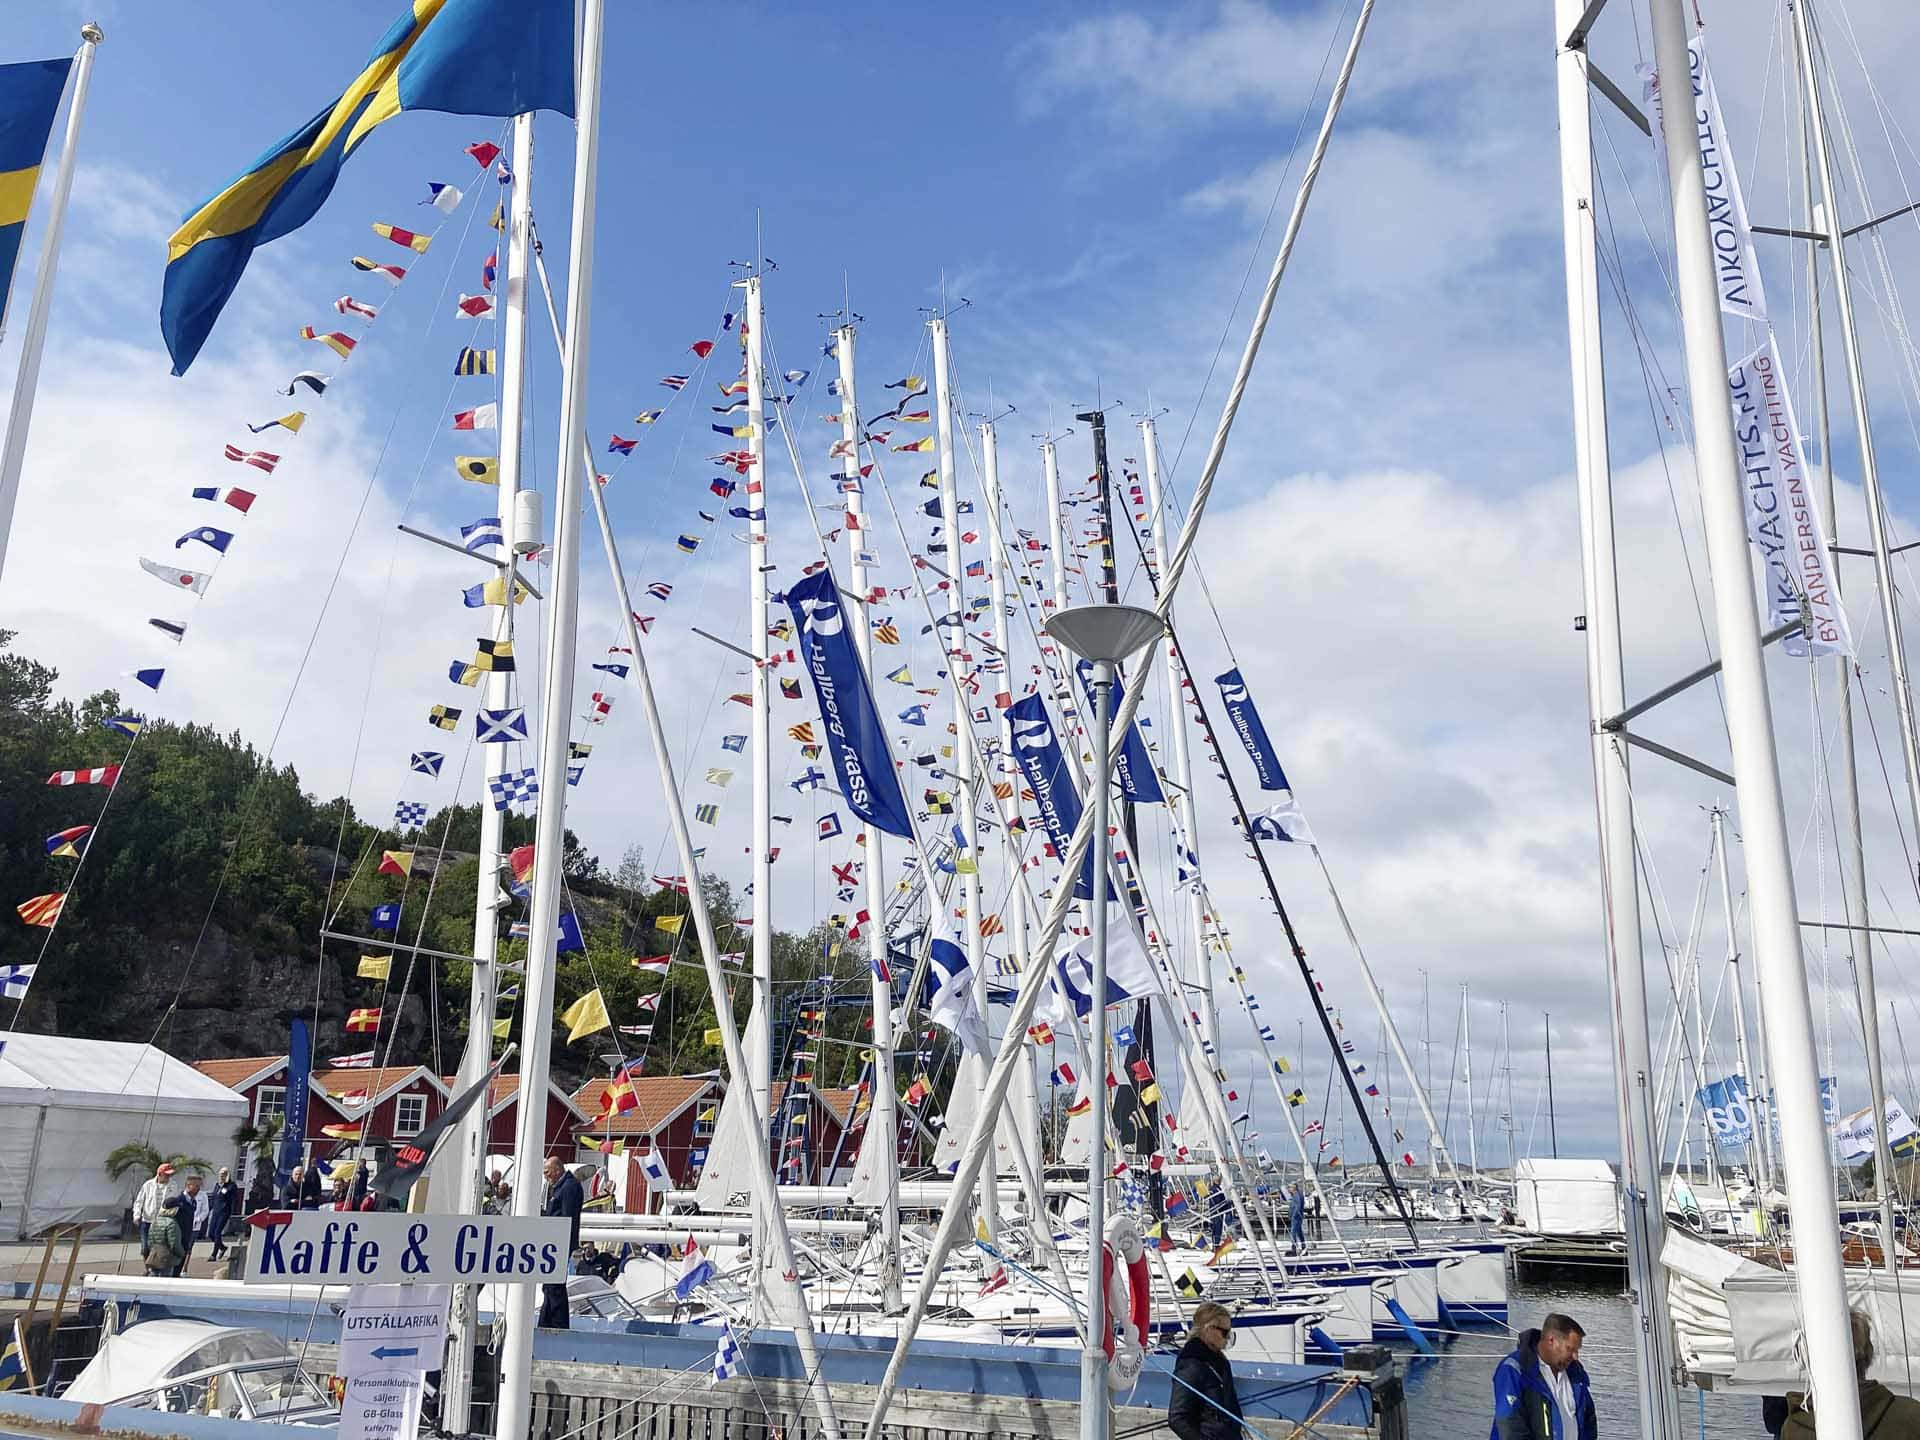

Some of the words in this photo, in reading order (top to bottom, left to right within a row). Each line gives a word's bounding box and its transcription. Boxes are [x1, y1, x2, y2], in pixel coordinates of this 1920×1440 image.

[1753, 356, 1797, 471] YACHTING
[1787, 478, 1830, 607] ANDERSEN
[1815, 615, 1838, 642] BY
[259, 1222, 379, 1275] Kaffe
[401, 1223, 432, 1275] &
[455, 1224, 558, 1275] Glass
[347, 1313, 439, 1329] UTSTÄLLARFIKA
